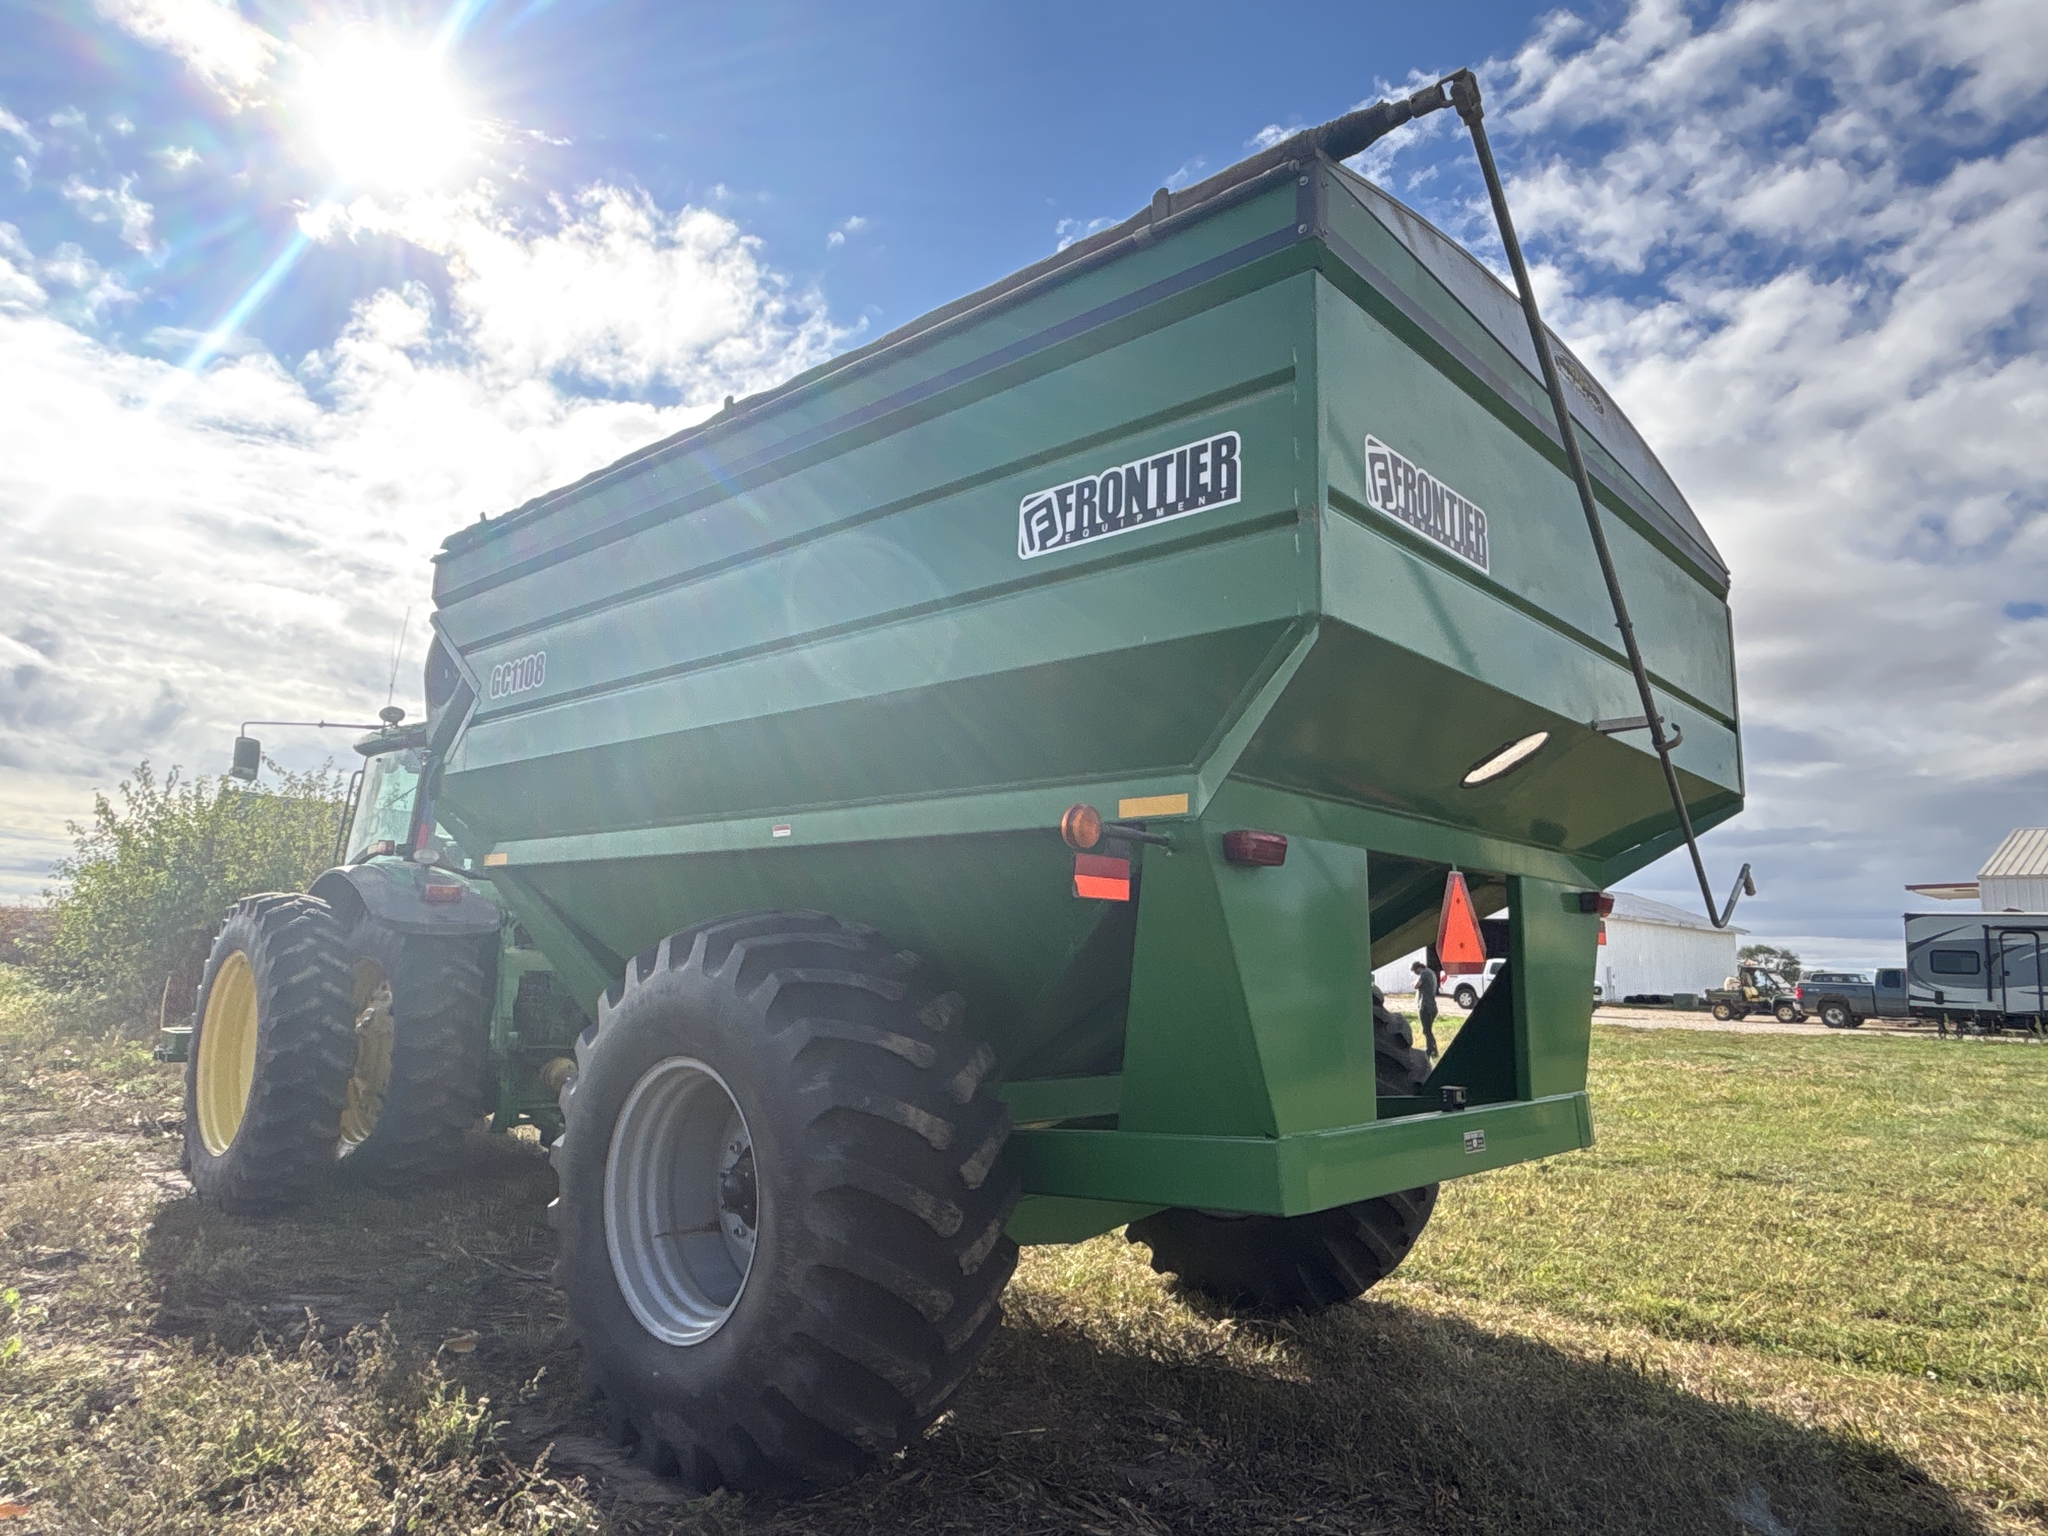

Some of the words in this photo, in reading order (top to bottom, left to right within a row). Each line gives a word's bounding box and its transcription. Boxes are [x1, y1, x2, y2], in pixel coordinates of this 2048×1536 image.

[1053, 435, 1239, 534] FRONTIER
[1388, 450, 1488, 557] FRONTIER
[1064, 489, 1228, 543] EQUIPMENT
[1398, 508, 1486, 566] EQUIPMENT
[490, 651, 546, 699] GC1108
